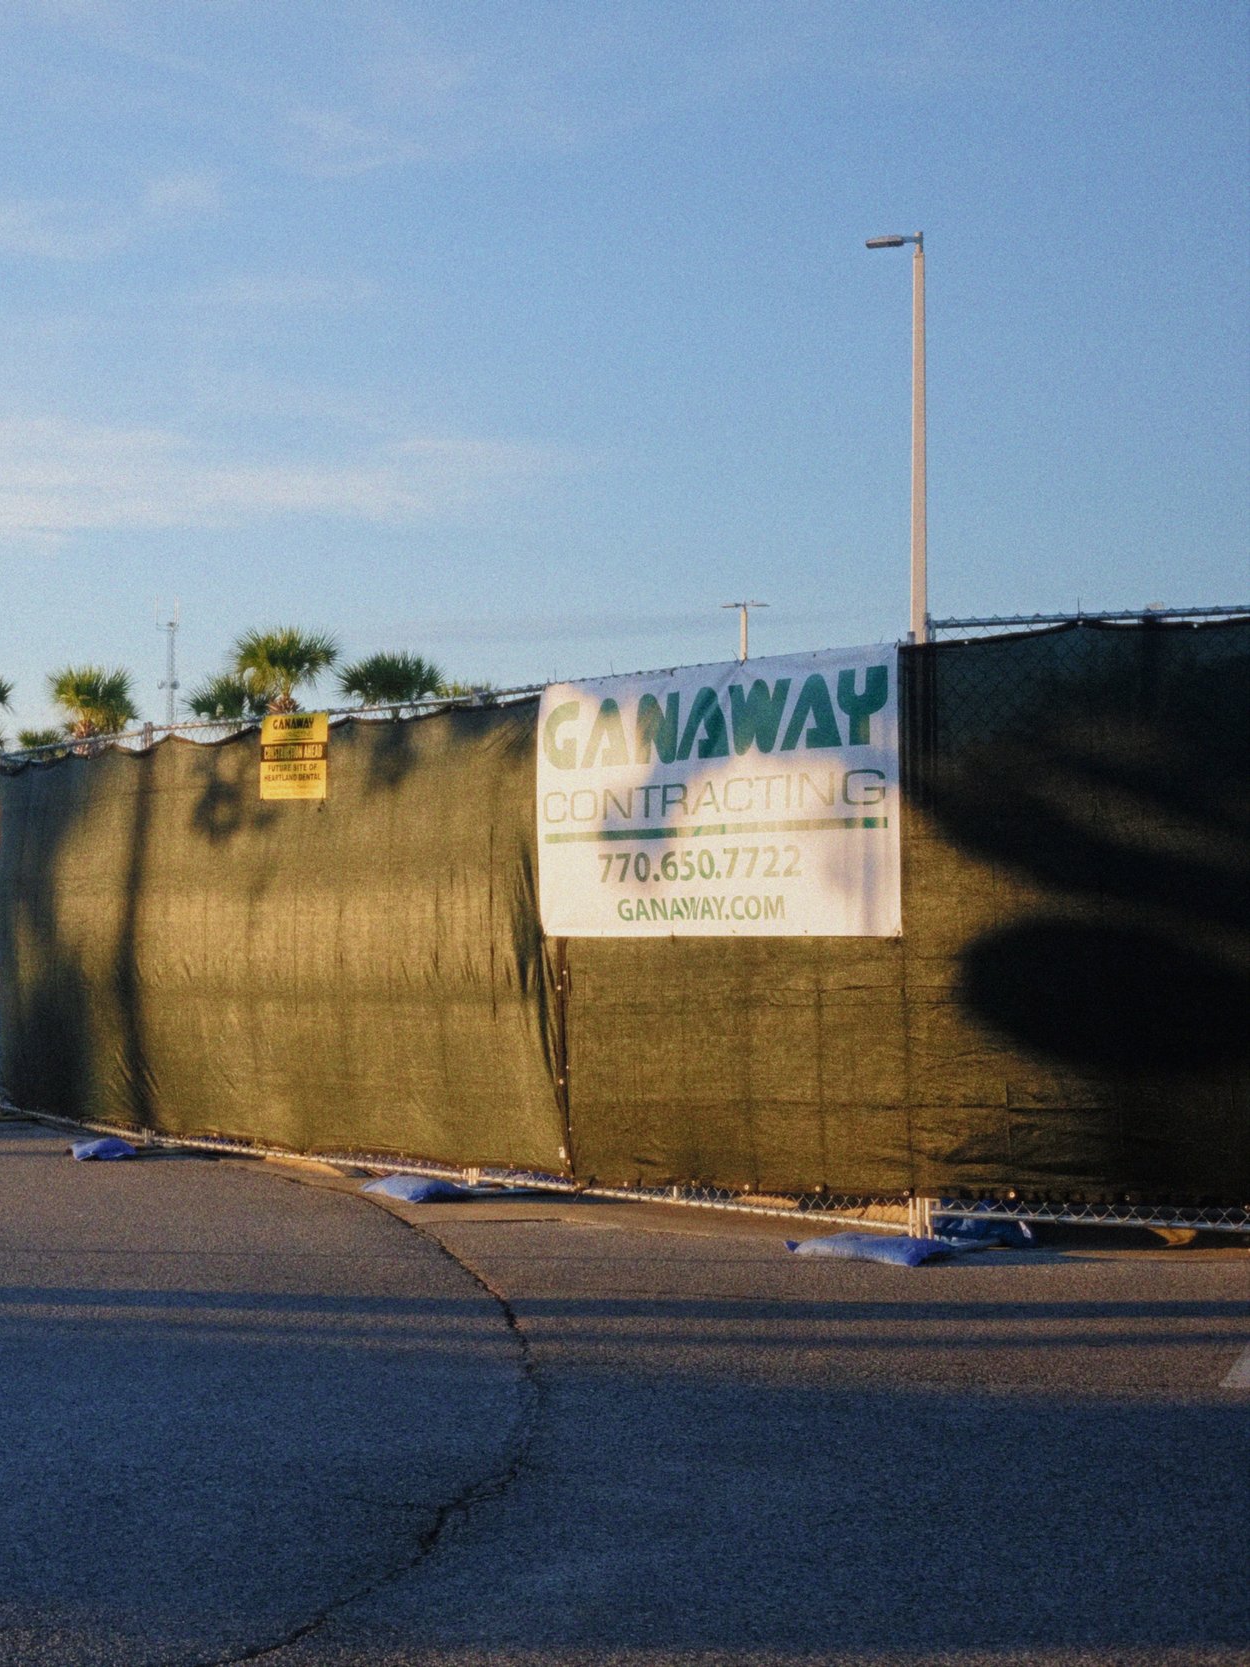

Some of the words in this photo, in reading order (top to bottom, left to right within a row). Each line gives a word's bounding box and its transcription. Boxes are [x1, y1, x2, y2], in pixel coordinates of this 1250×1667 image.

[273, 717, 314, 730] GANAWAY
[543, 665, 889, 770] GANAWAY
[264, 774, 298, 782] HEARTLAND
[298, 773, 321, 781] DENTAL
[268, 764, 291, 772] FUTURE
[292, 763, 307, 771] SITE
[543, 769, 886, 824] CONTRACTING
[597, 845, 803, 883] 770.650.7722
[617, 895, 786, 921] GANAWAY.COM
